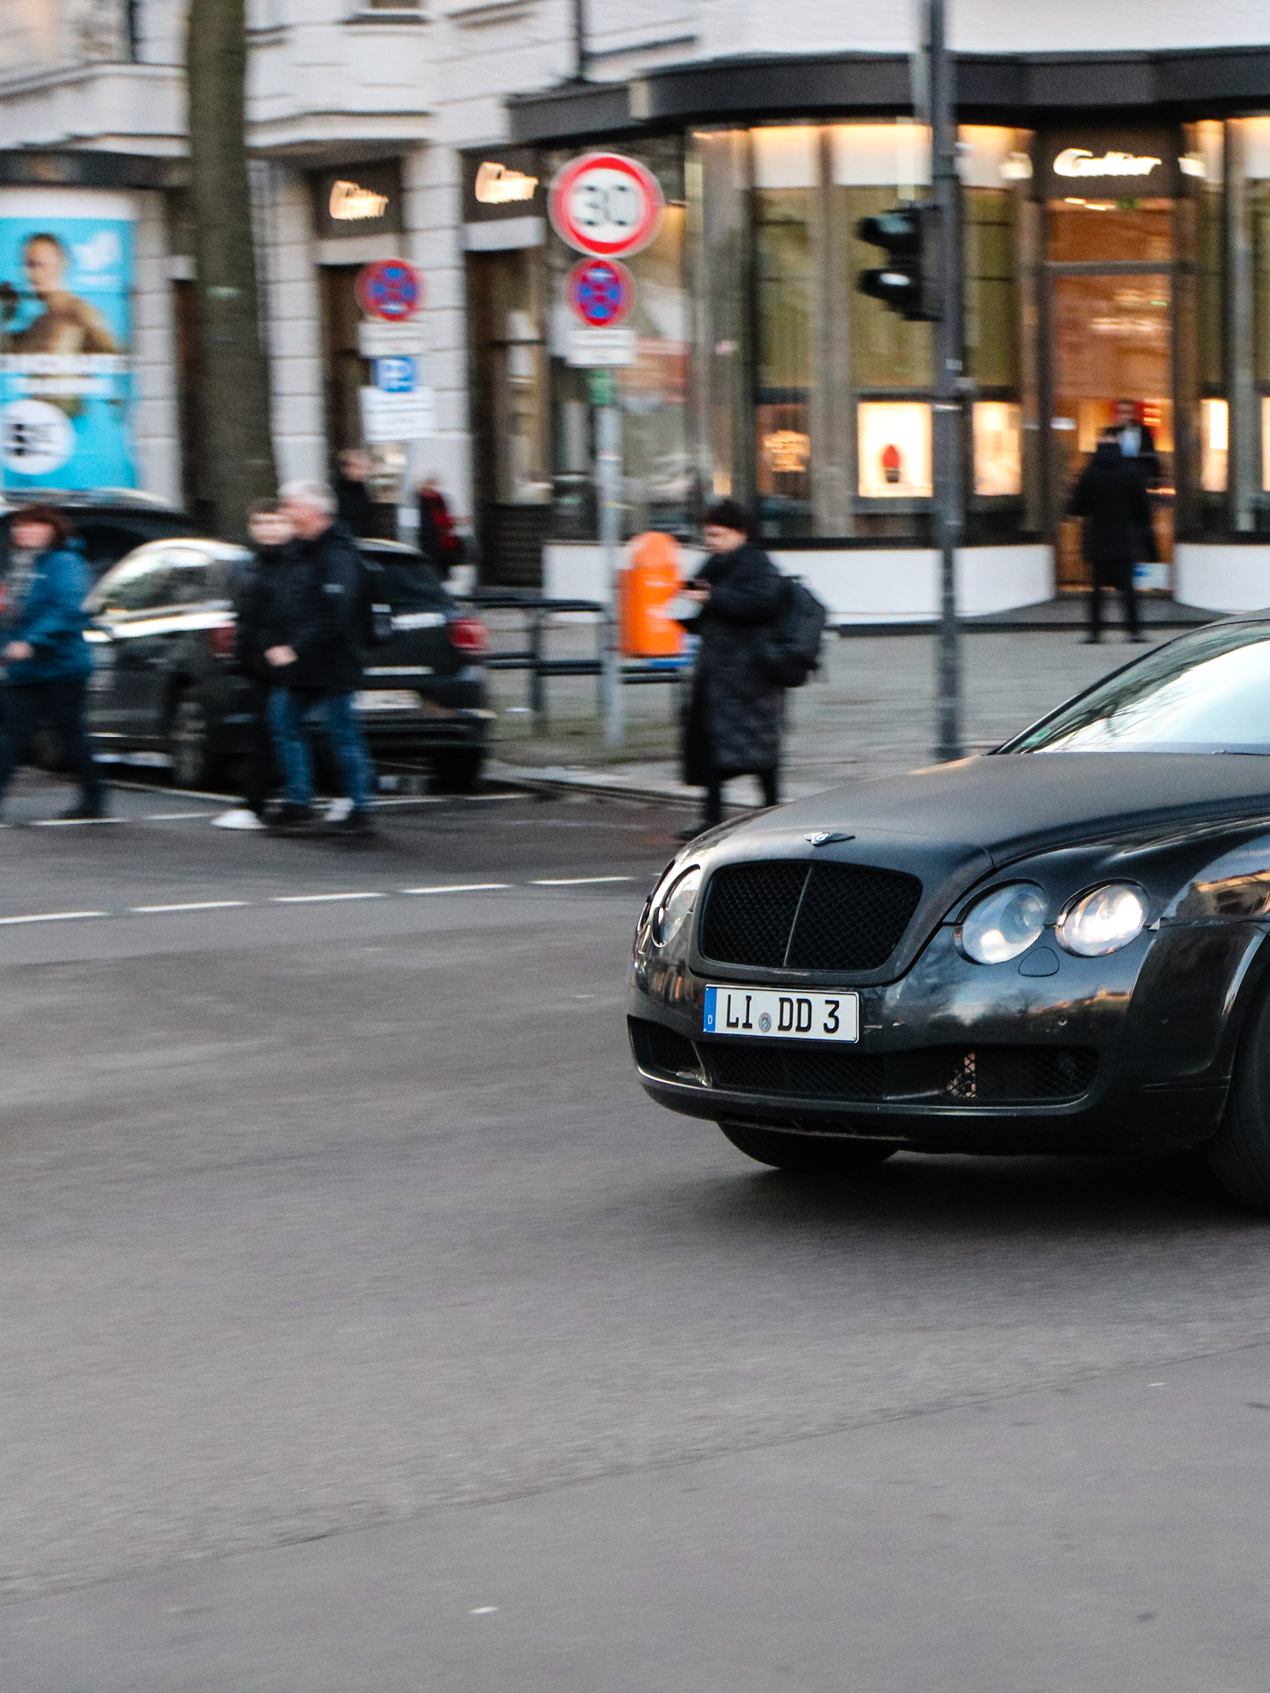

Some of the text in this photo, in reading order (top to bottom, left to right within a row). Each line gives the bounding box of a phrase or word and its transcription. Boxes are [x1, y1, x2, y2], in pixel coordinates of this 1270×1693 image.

[575, 184, 640, 227] 30
[707, 1014, 713, 1025] D
[726, 994, 840, 1034] LI DD 3
